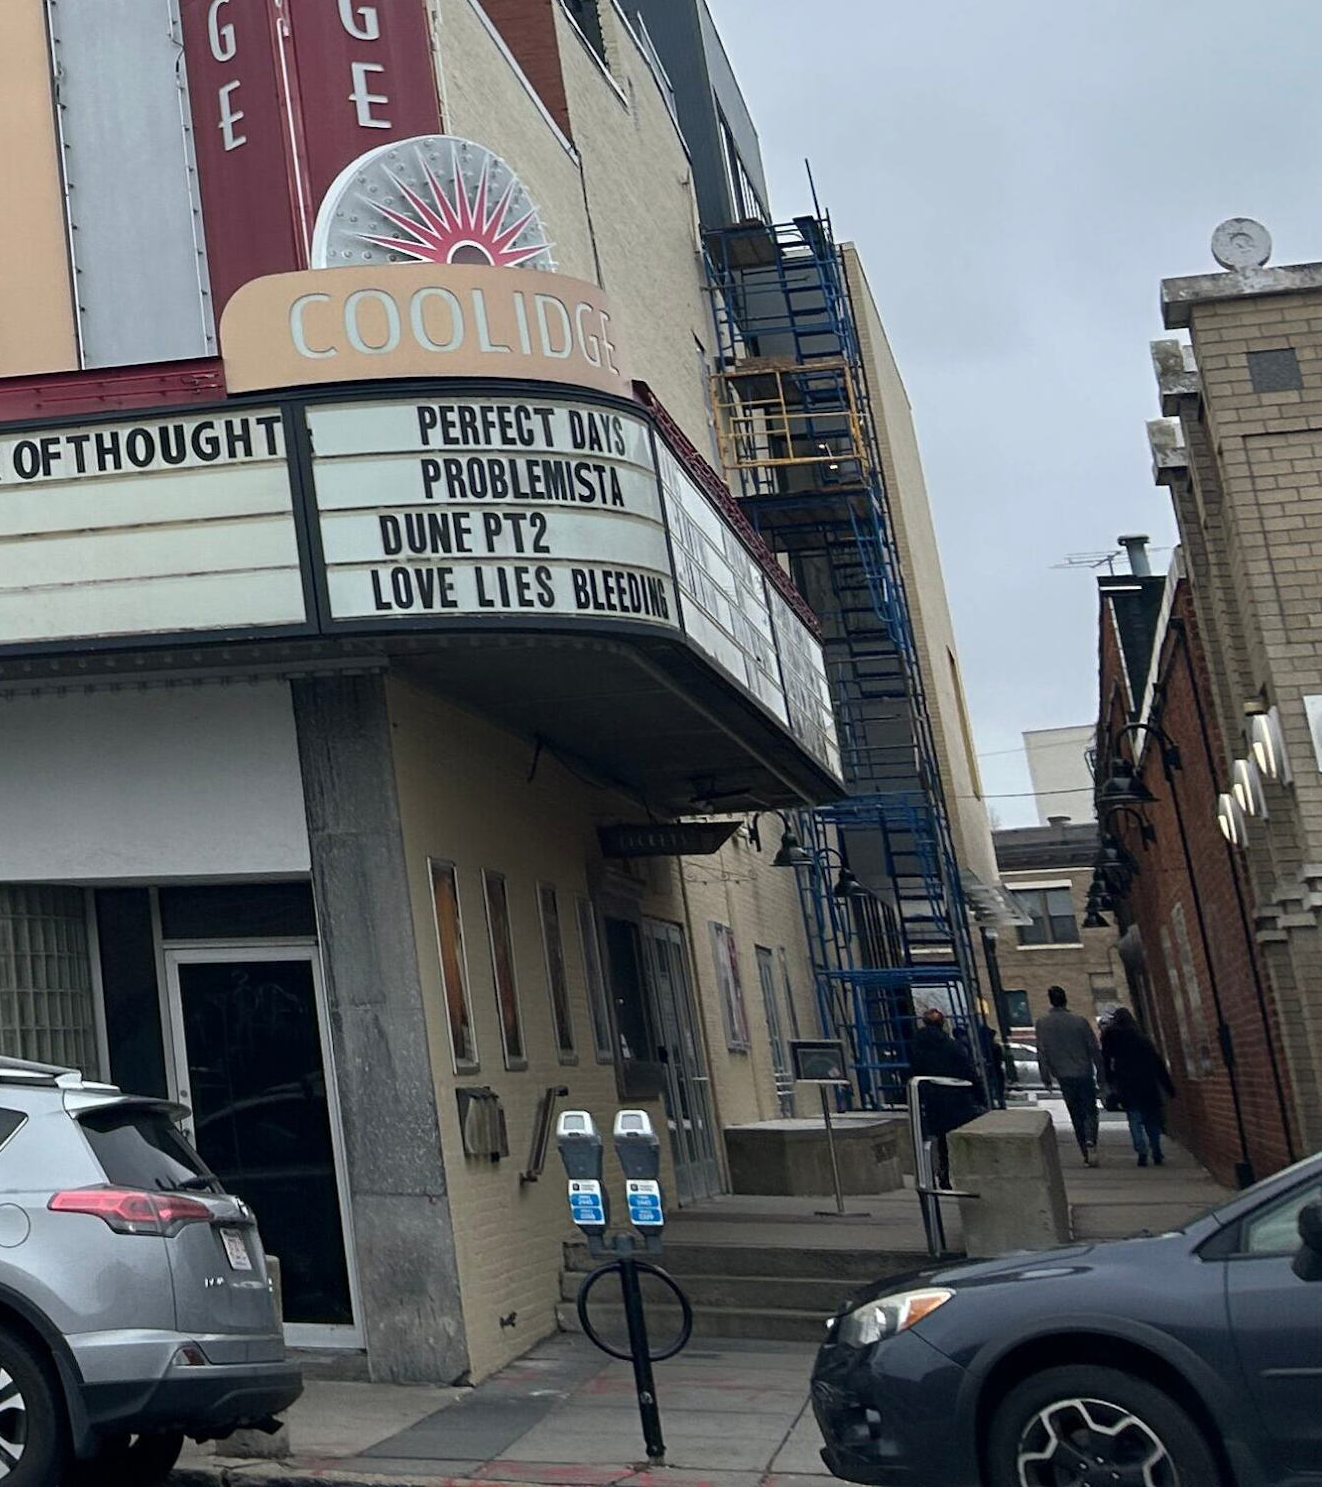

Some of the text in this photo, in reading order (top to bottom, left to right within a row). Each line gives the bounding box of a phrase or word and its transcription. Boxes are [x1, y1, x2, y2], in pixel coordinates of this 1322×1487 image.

[288, 287, 621, 377] COOLIDGE
[419, 404, 626, 457] PERFECT DAYS
[421, 458, 625, 508] PROBLEMISTA
[380, 512, 552, 556] DUNE PT2
[370, 566, 670, 620] LOVE LIES BLEEDING
